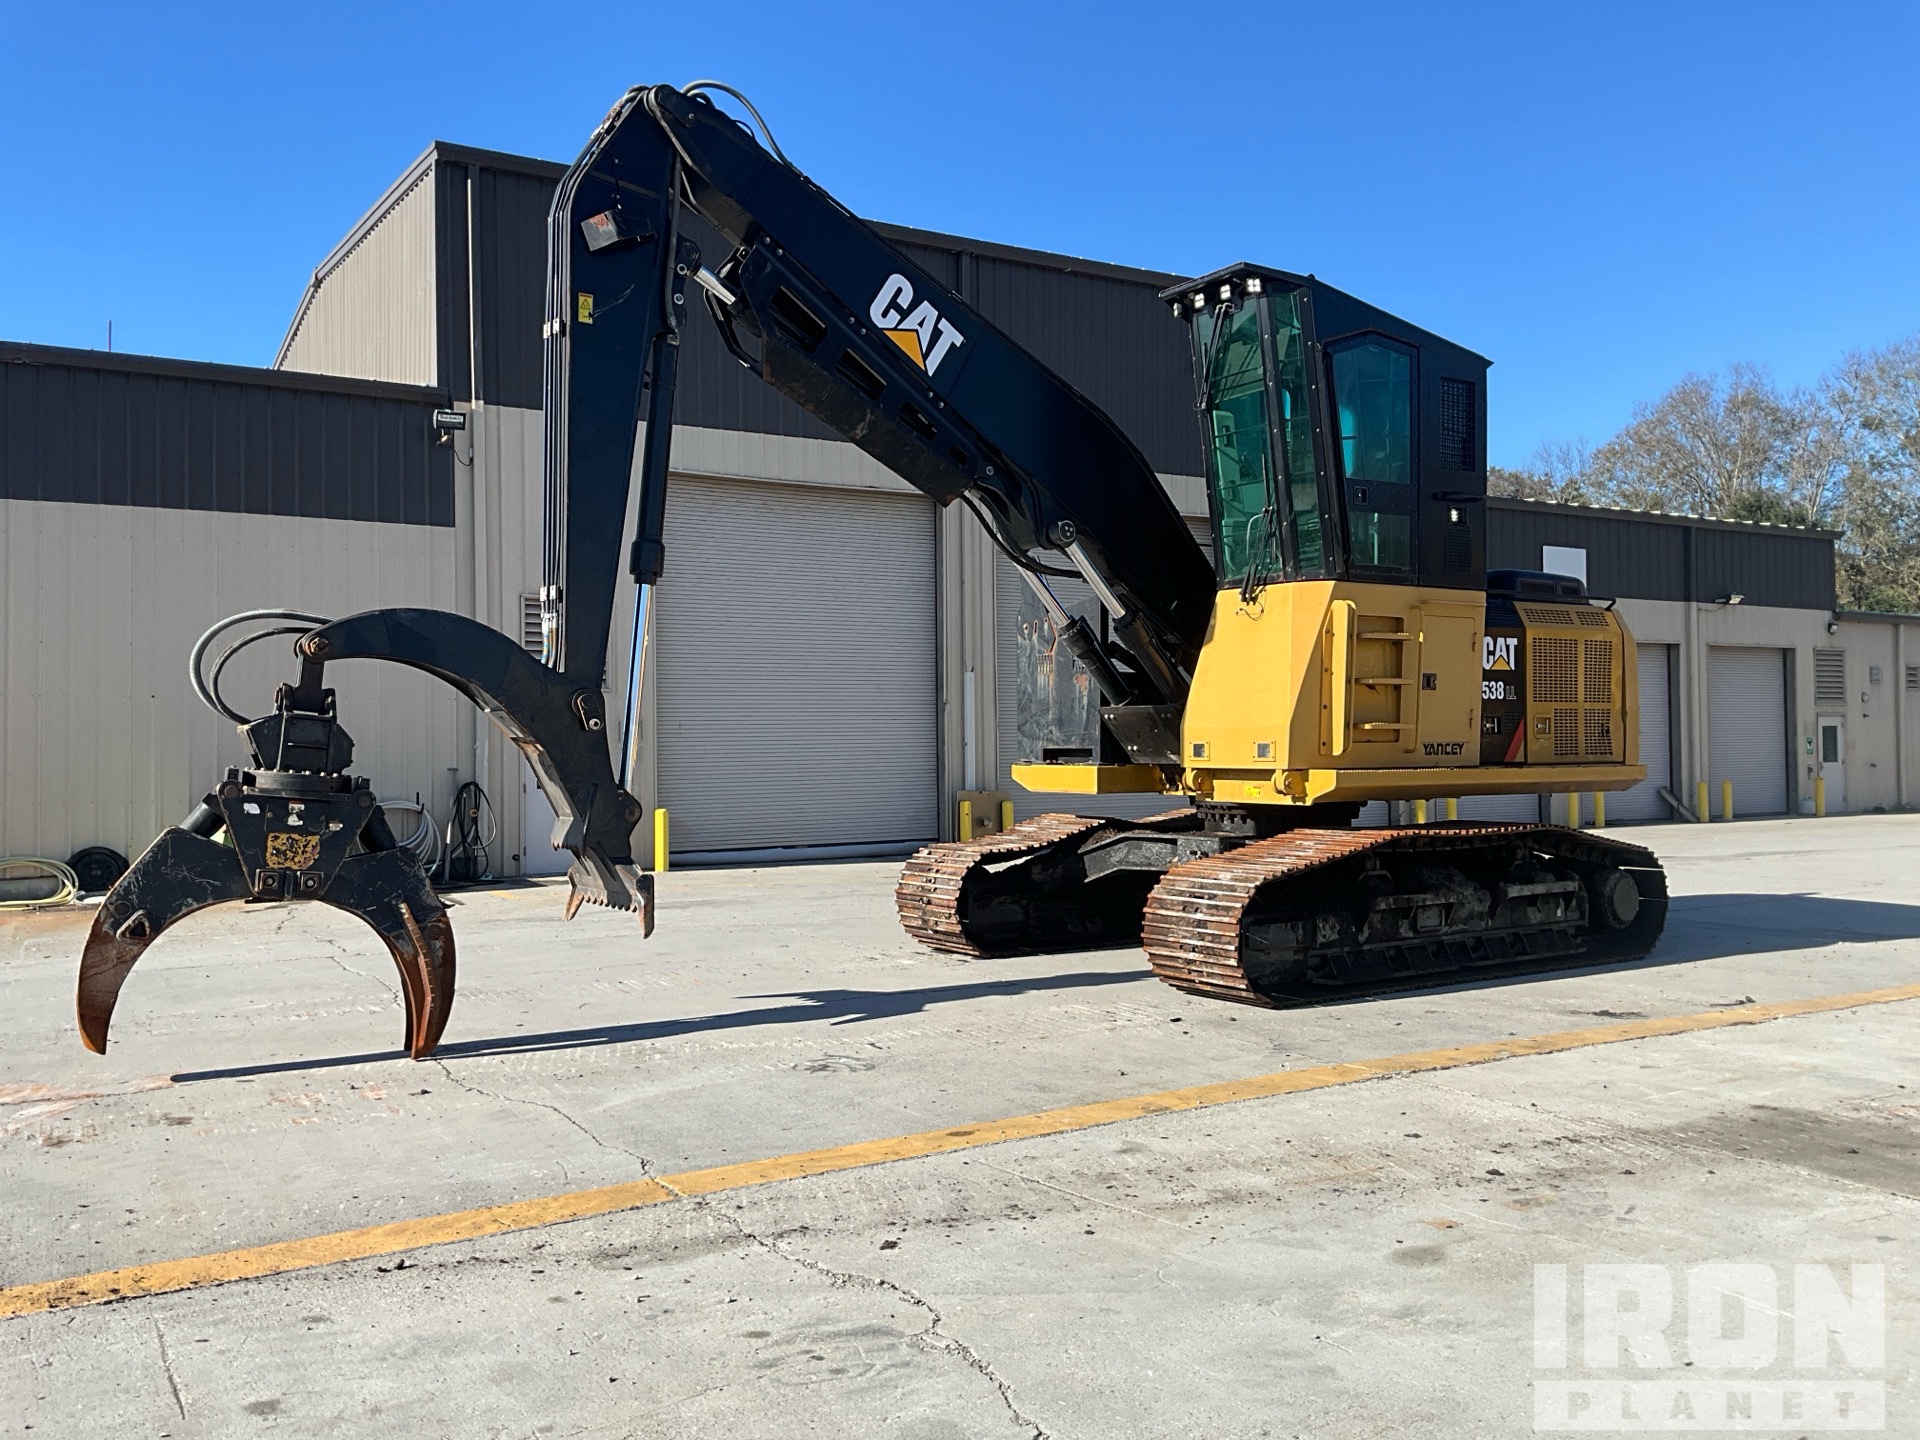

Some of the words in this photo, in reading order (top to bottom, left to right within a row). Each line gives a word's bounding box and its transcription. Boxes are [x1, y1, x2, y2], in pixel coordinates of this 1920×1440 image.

[869, 273, 964, 377] CAT
[1482, 635, 1518, 671] CAT
[1482, 681, 1505, 700] 538
[1422, 743, 1464, 756] YANCEY
